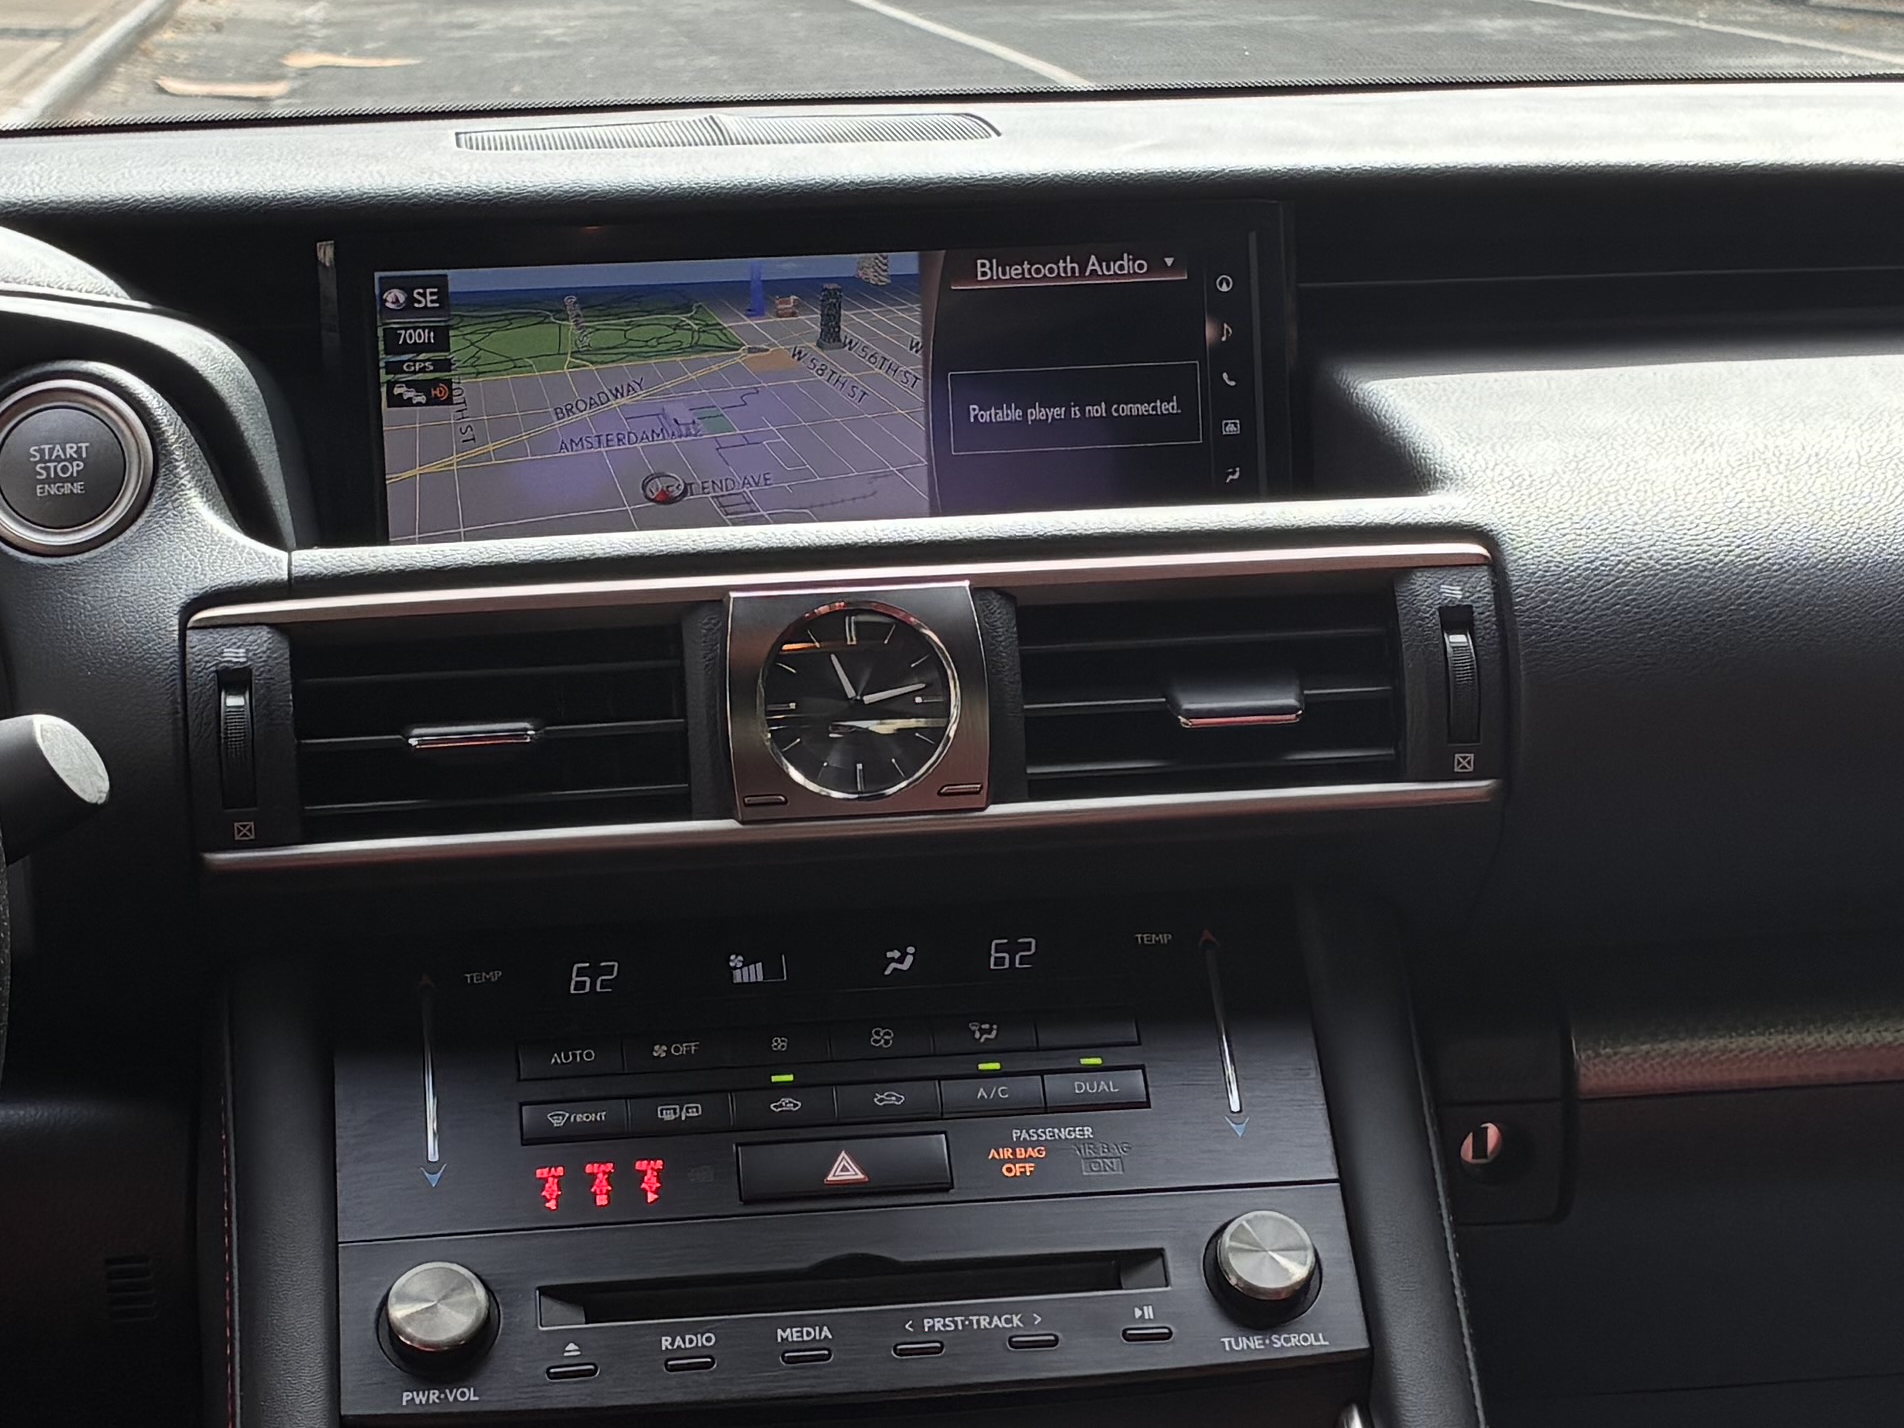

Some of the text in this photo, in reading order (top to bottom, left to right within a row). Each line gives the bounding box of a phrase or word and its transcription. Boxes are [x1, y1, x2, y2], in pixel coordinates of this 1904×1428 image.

[976, 253, 1148, 281] Bluetooth Audio
[413, 288, 440, 308] SE
[397, 328, 435, 345] 700ft
[403, 360, 434, 372] GPS
[842, 335, 922, 390] W 56TH ST
[791, 345, 870, 405] W 58TH ST
[554, 376, 645, 421] BROADWAY
[969, 396, 1181, 424] Portable player is not connected.
[459, 425, 476, 444] ST
[558, 427, 666, 453] AMSTERDAM
[29, 442, 90, 462] START
[35, 461, 85, 480] STOP
[36, 481, 86, 497] ENGINE
[700, 475, 736, 494] END
[740, 472, 773, 489] AVE
[1134, 933, 1172, 945] TEMP
[990, 938, 1037, 970] 62
[463, 970, 503, 984] TEMP
[569, 961, 619, 994] 62
[550, 1048, 596, 1066] AUTO
[670, 1041, 701, 1056] OFF
[976, 1085, 1010, 1100] A/C
[1074, 1080, 1120, 1095] DUAL
[1012, 1126, 1094, 1141] PASSENGER
[988, 1146, 1047, 1160] AIR BAG
[1001, 1163, 1036, 1178] OFF
[661, 1332, 717, 1351] RADIO
[776, 1325, 833, 1343] MEDIA
